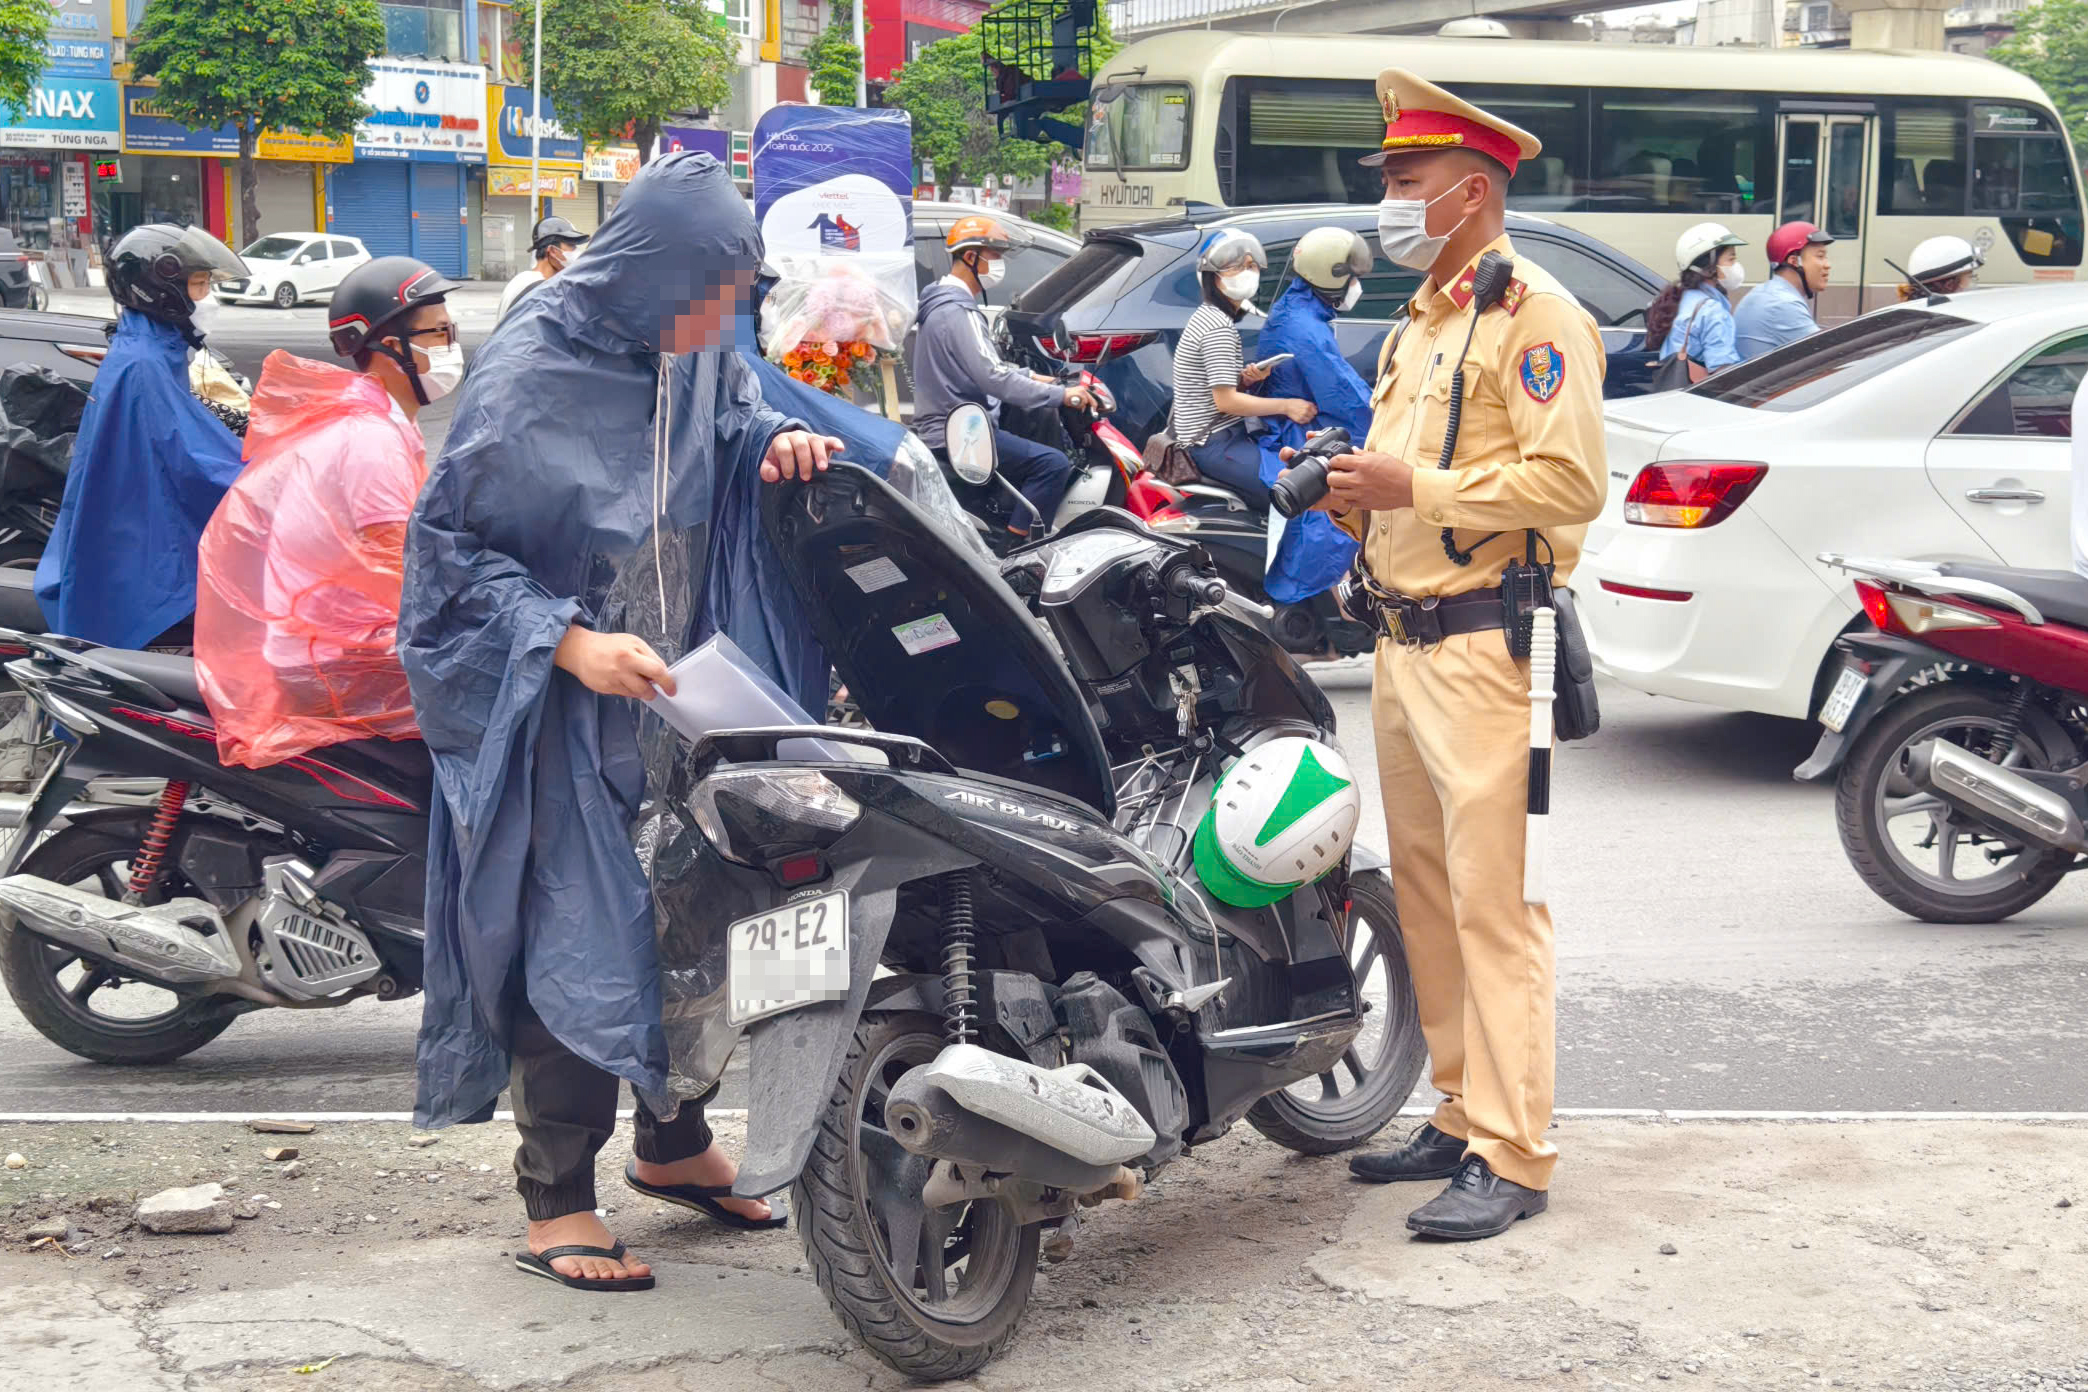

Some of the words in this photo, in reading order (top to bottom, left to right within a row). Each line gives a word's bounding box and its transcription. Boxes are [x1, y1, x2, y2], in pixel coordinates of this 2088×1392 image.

[85, 136, 108, 145] NGA
[783, 132, 798, 141] báo
[789, 142, 810, 152] quốc
[811, 143, 834, 152] 2025
[1100, 184, 1153, 206] HYUNDAI
[944, 790, 995, 811] AIR
[999, 800, 1082, 836] BLADE
[787, 889, 824, 903] HONDA
[745, 902, 828, 951] 29-E2
